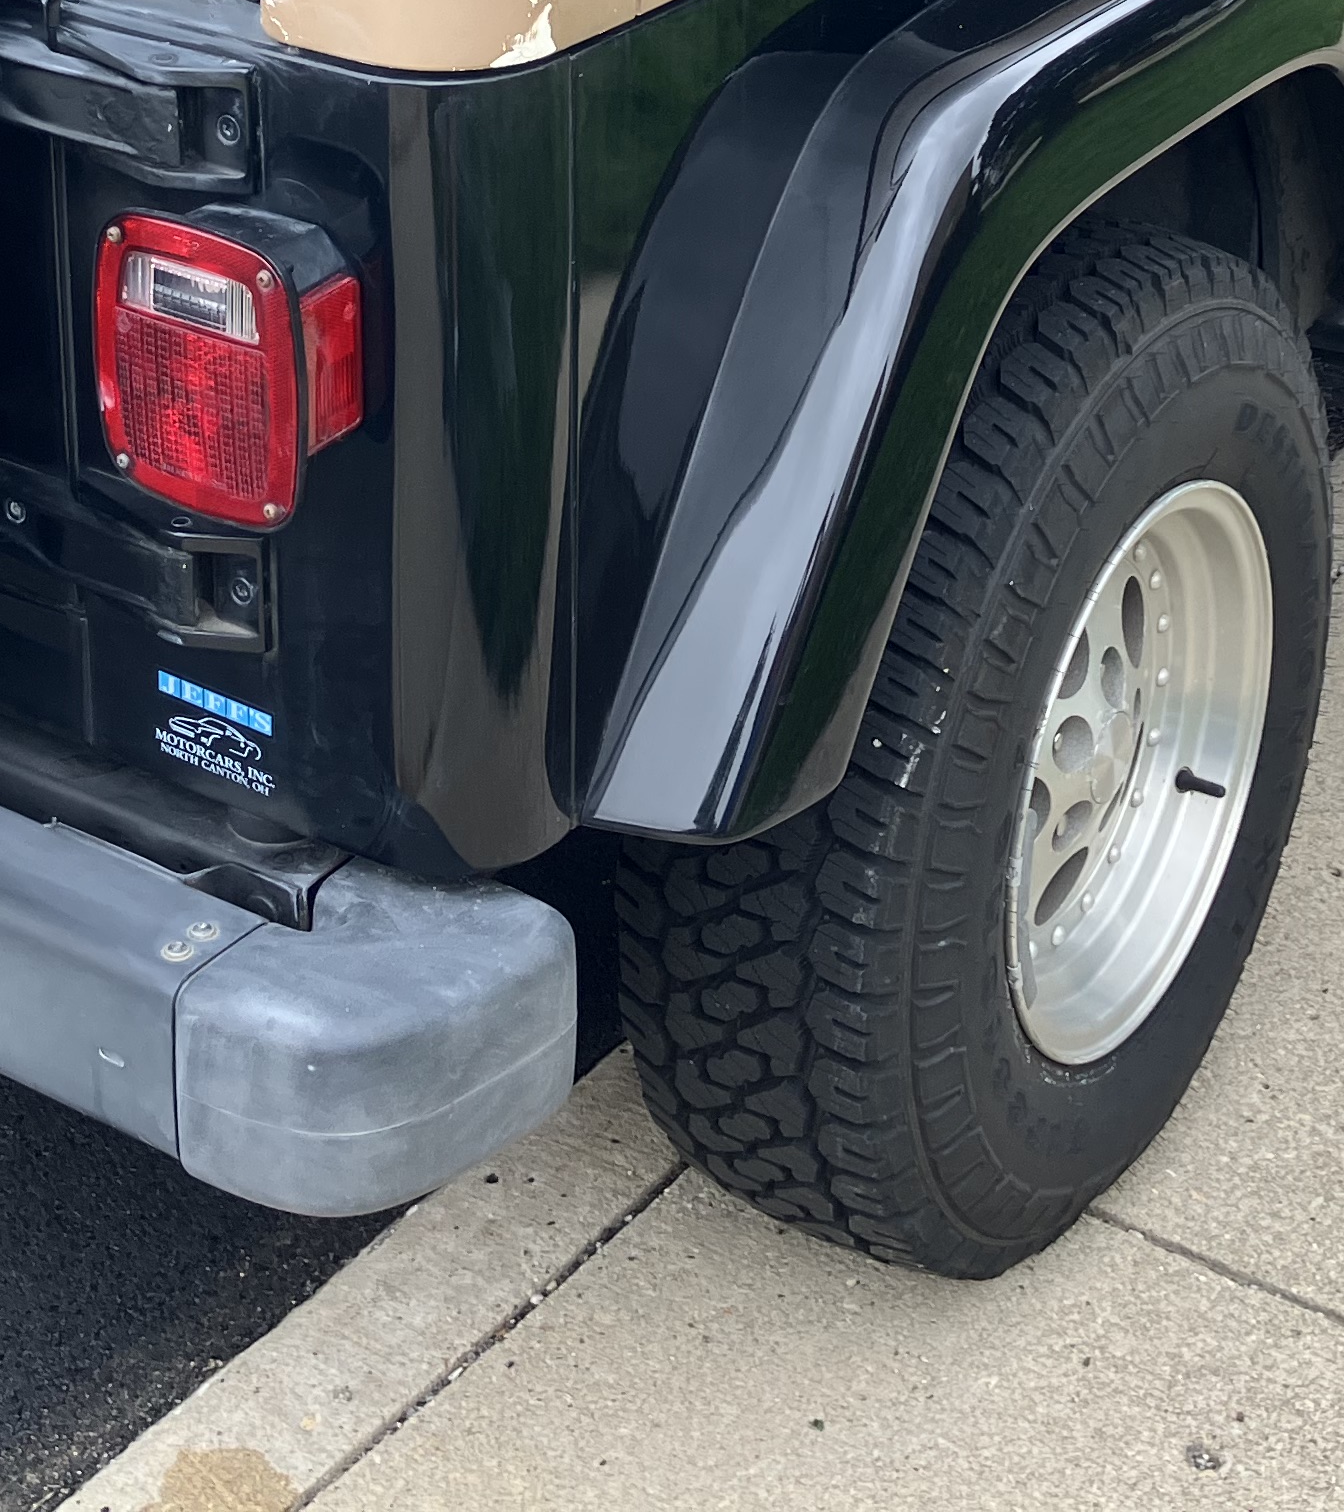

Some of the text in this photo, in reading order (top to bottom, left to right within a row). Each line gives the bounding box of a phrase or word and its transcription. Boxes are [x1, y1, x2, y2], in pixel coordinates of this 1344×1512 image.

[159, 673, 272, 735] JEFF'S
[155, 727, 276, 789] MOTORCARS, INC.
[160, 741, 270, 797] NORTH CANTON, OH
